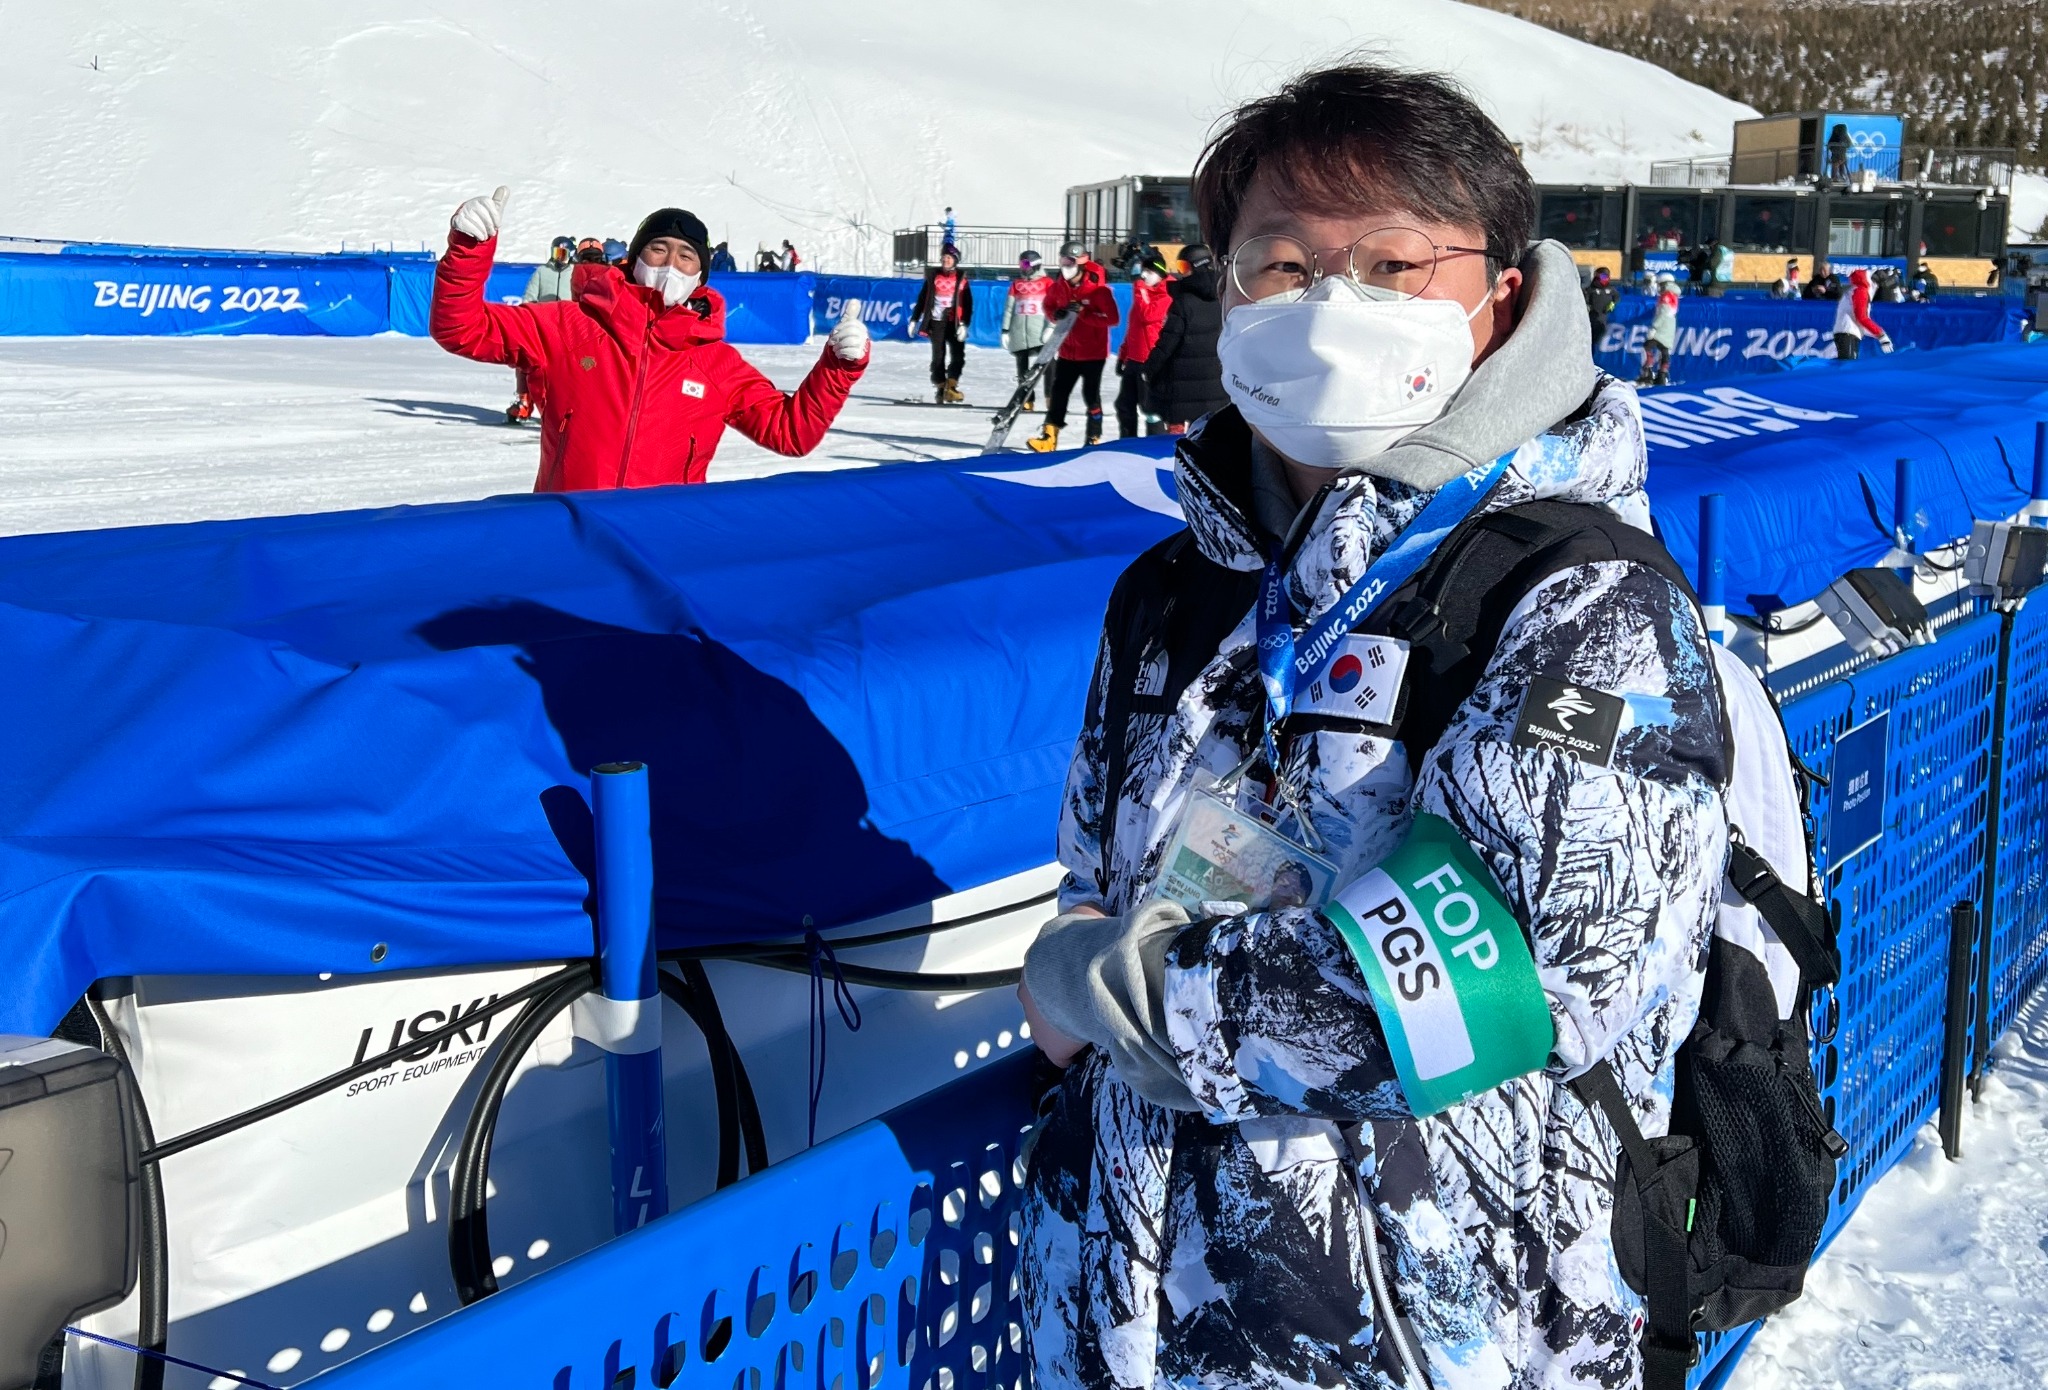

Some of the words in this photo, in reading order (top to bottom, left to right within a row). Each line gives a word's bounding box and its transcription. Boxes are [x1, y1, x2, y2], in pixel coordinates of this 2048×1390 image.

[94, 281, 211, 317] BEIJING
[220, 286, 308, 313] 2022
[1018, 303, 1037, 315] 13
[1600, 322, 1733, 361] BEING
[1231, 373, 1250, 396] Team
[1250, 384, 1280, 407] Korea
[1295, 618, 1349, 675] BEIJING
[1345, 577, 1389, 622] 2022
[1527, 723, 1566, 743] BEIJING
[1412, 862, 1499, 970] FOP
[1361, 896, 1440, 1002] PGS
[346, 1071, 399, 1097] SPORT
[402, 1046, 486, 1082] EQUIPMENT
